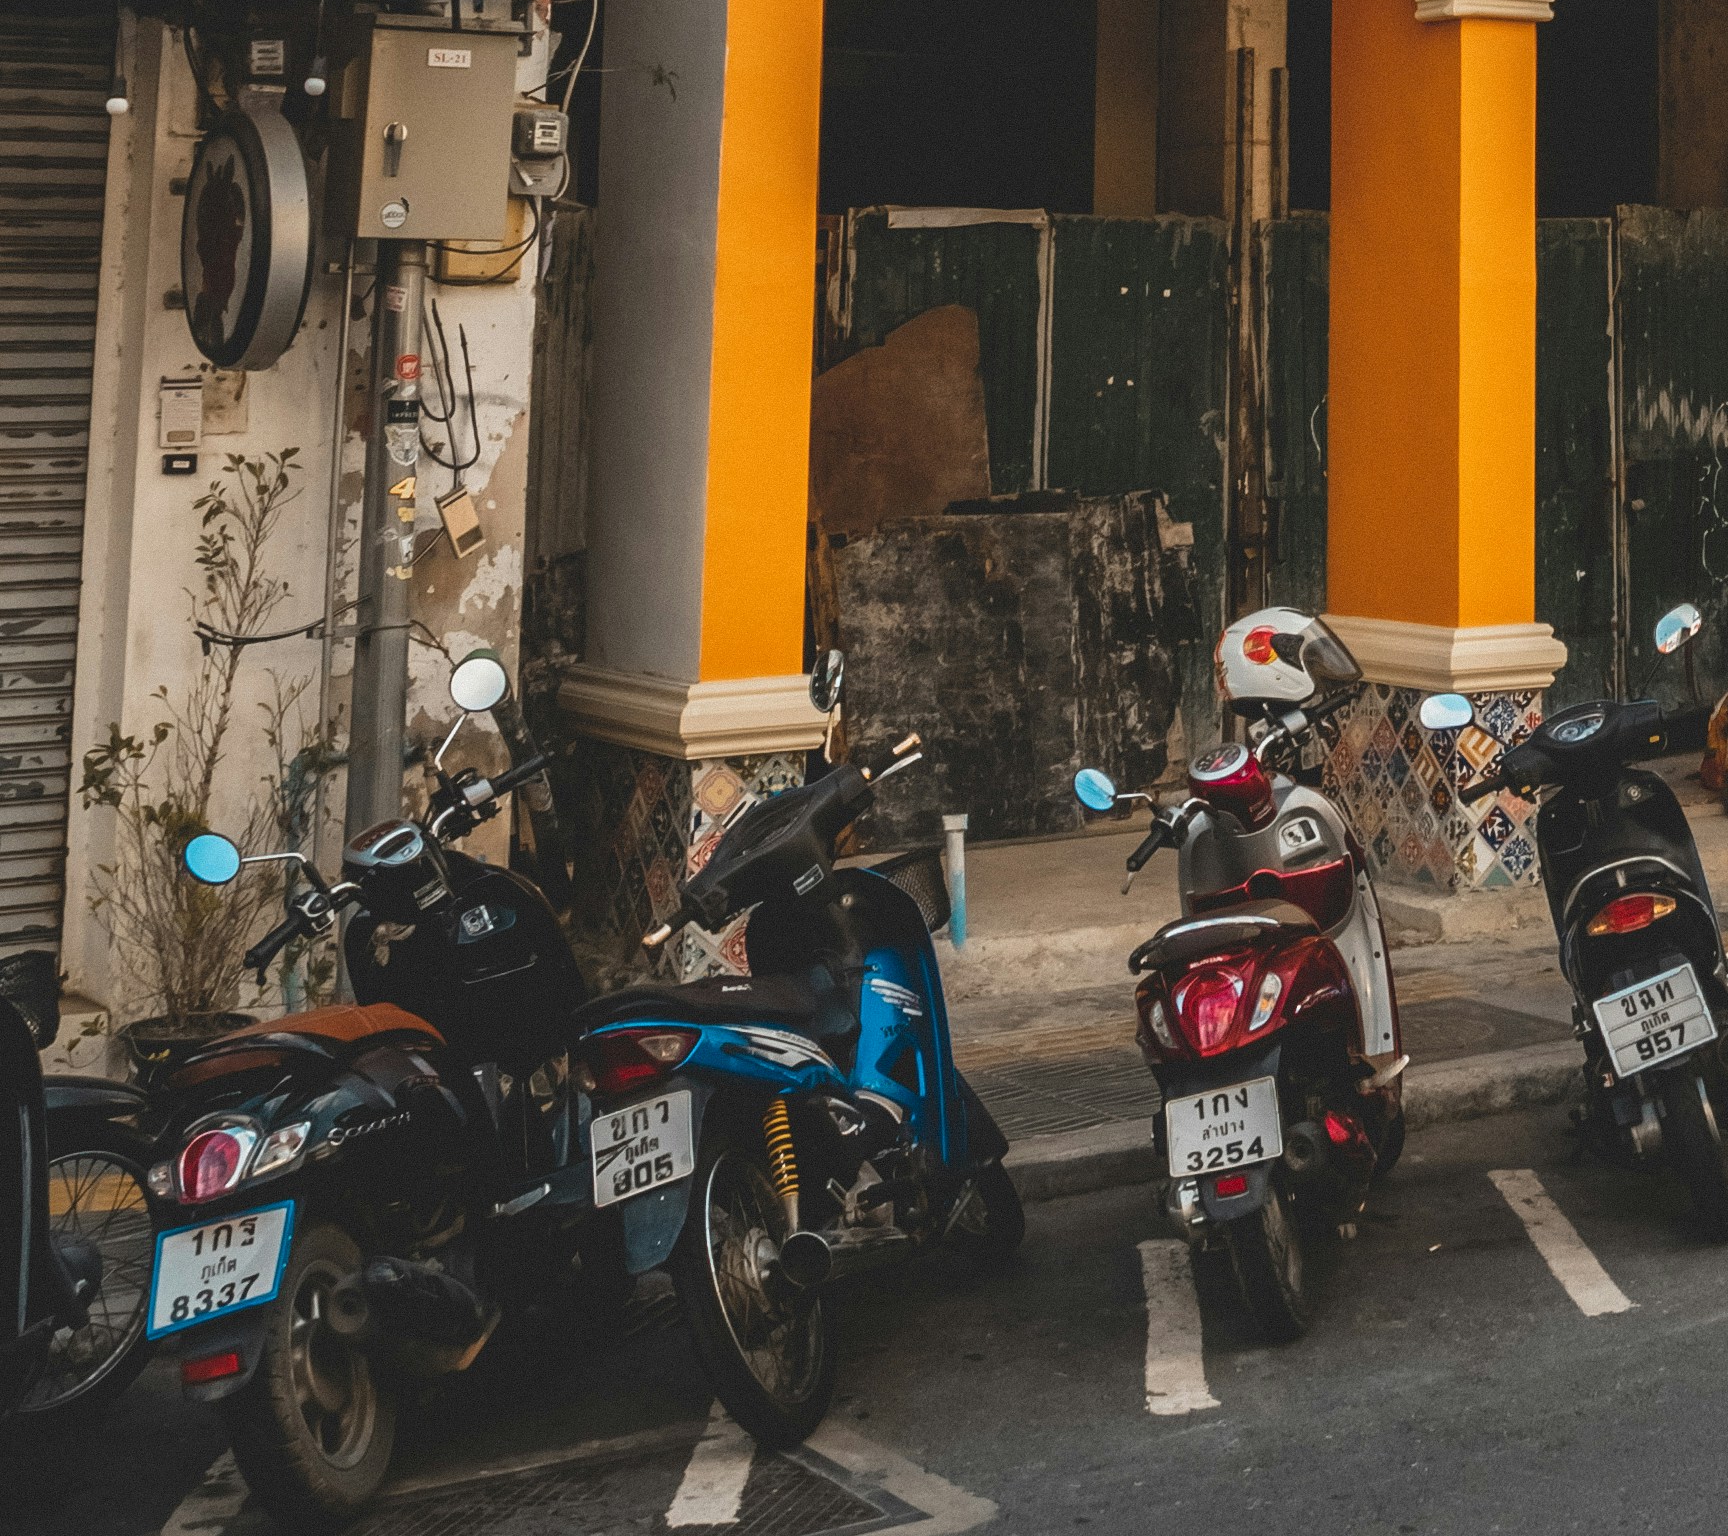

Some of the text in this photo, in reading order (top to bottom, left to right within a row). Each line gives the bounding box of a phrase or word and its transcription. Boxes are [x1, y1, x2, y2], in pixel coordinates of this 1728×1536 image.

[1641, 1011, 1671, 1034] ภูเก็ต
[1636, 1023, 1685, 1061] 957
[1194, 1088, 1249, 1120] 1กง
[1186, 1136, 1265, 1172] 3254
[613, 1152, 674, 1197] 805
[201, 1255, 237, 1285] ภูเก็ต
[170, 1273, 260, 1323] 8337
